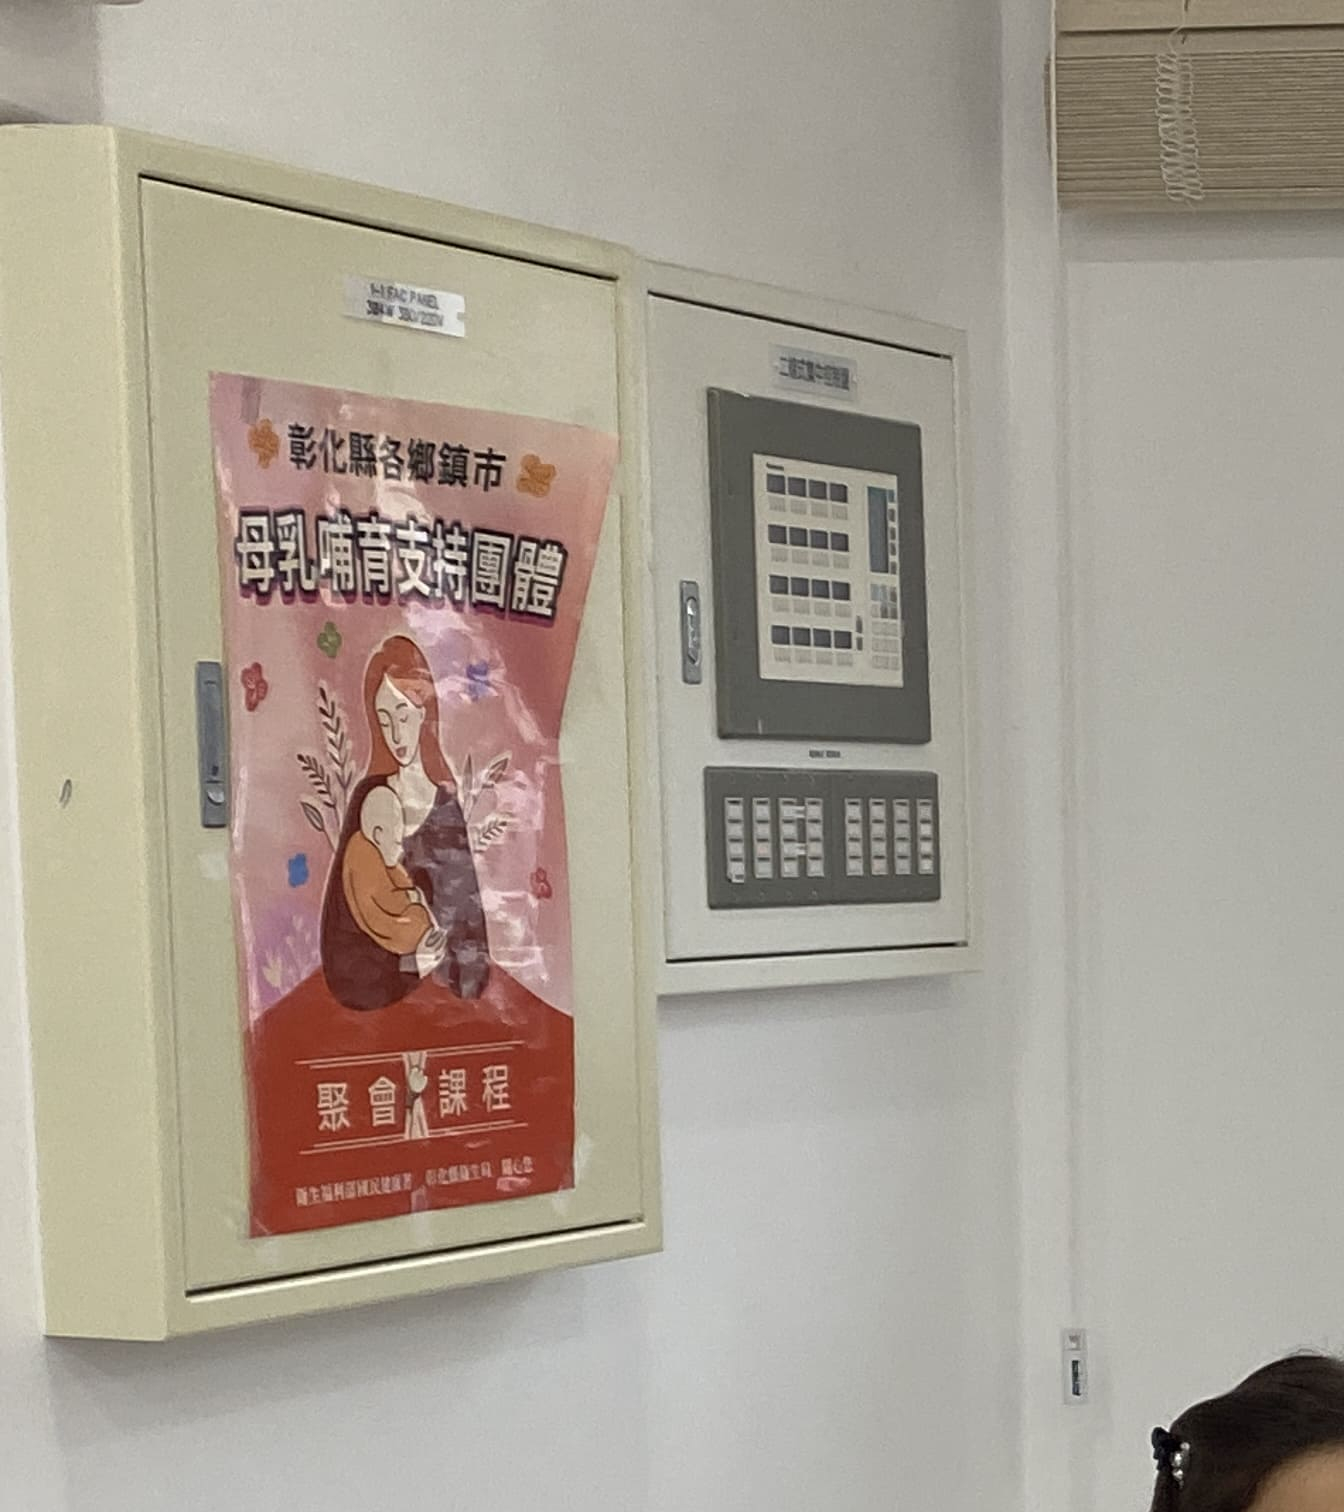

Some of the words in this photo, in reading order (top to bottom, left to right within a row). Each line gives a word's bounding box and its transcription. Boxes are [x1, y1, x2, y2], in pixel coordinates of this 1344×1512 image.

[287, 422, 507, 492] 彰化縣各鄉鎮市
[235, 508, 566, 622] 母乳哺育支持團體
[316, 1075, 397, 1132] 聚會
[438, 1064, 512, 1119] 課程
